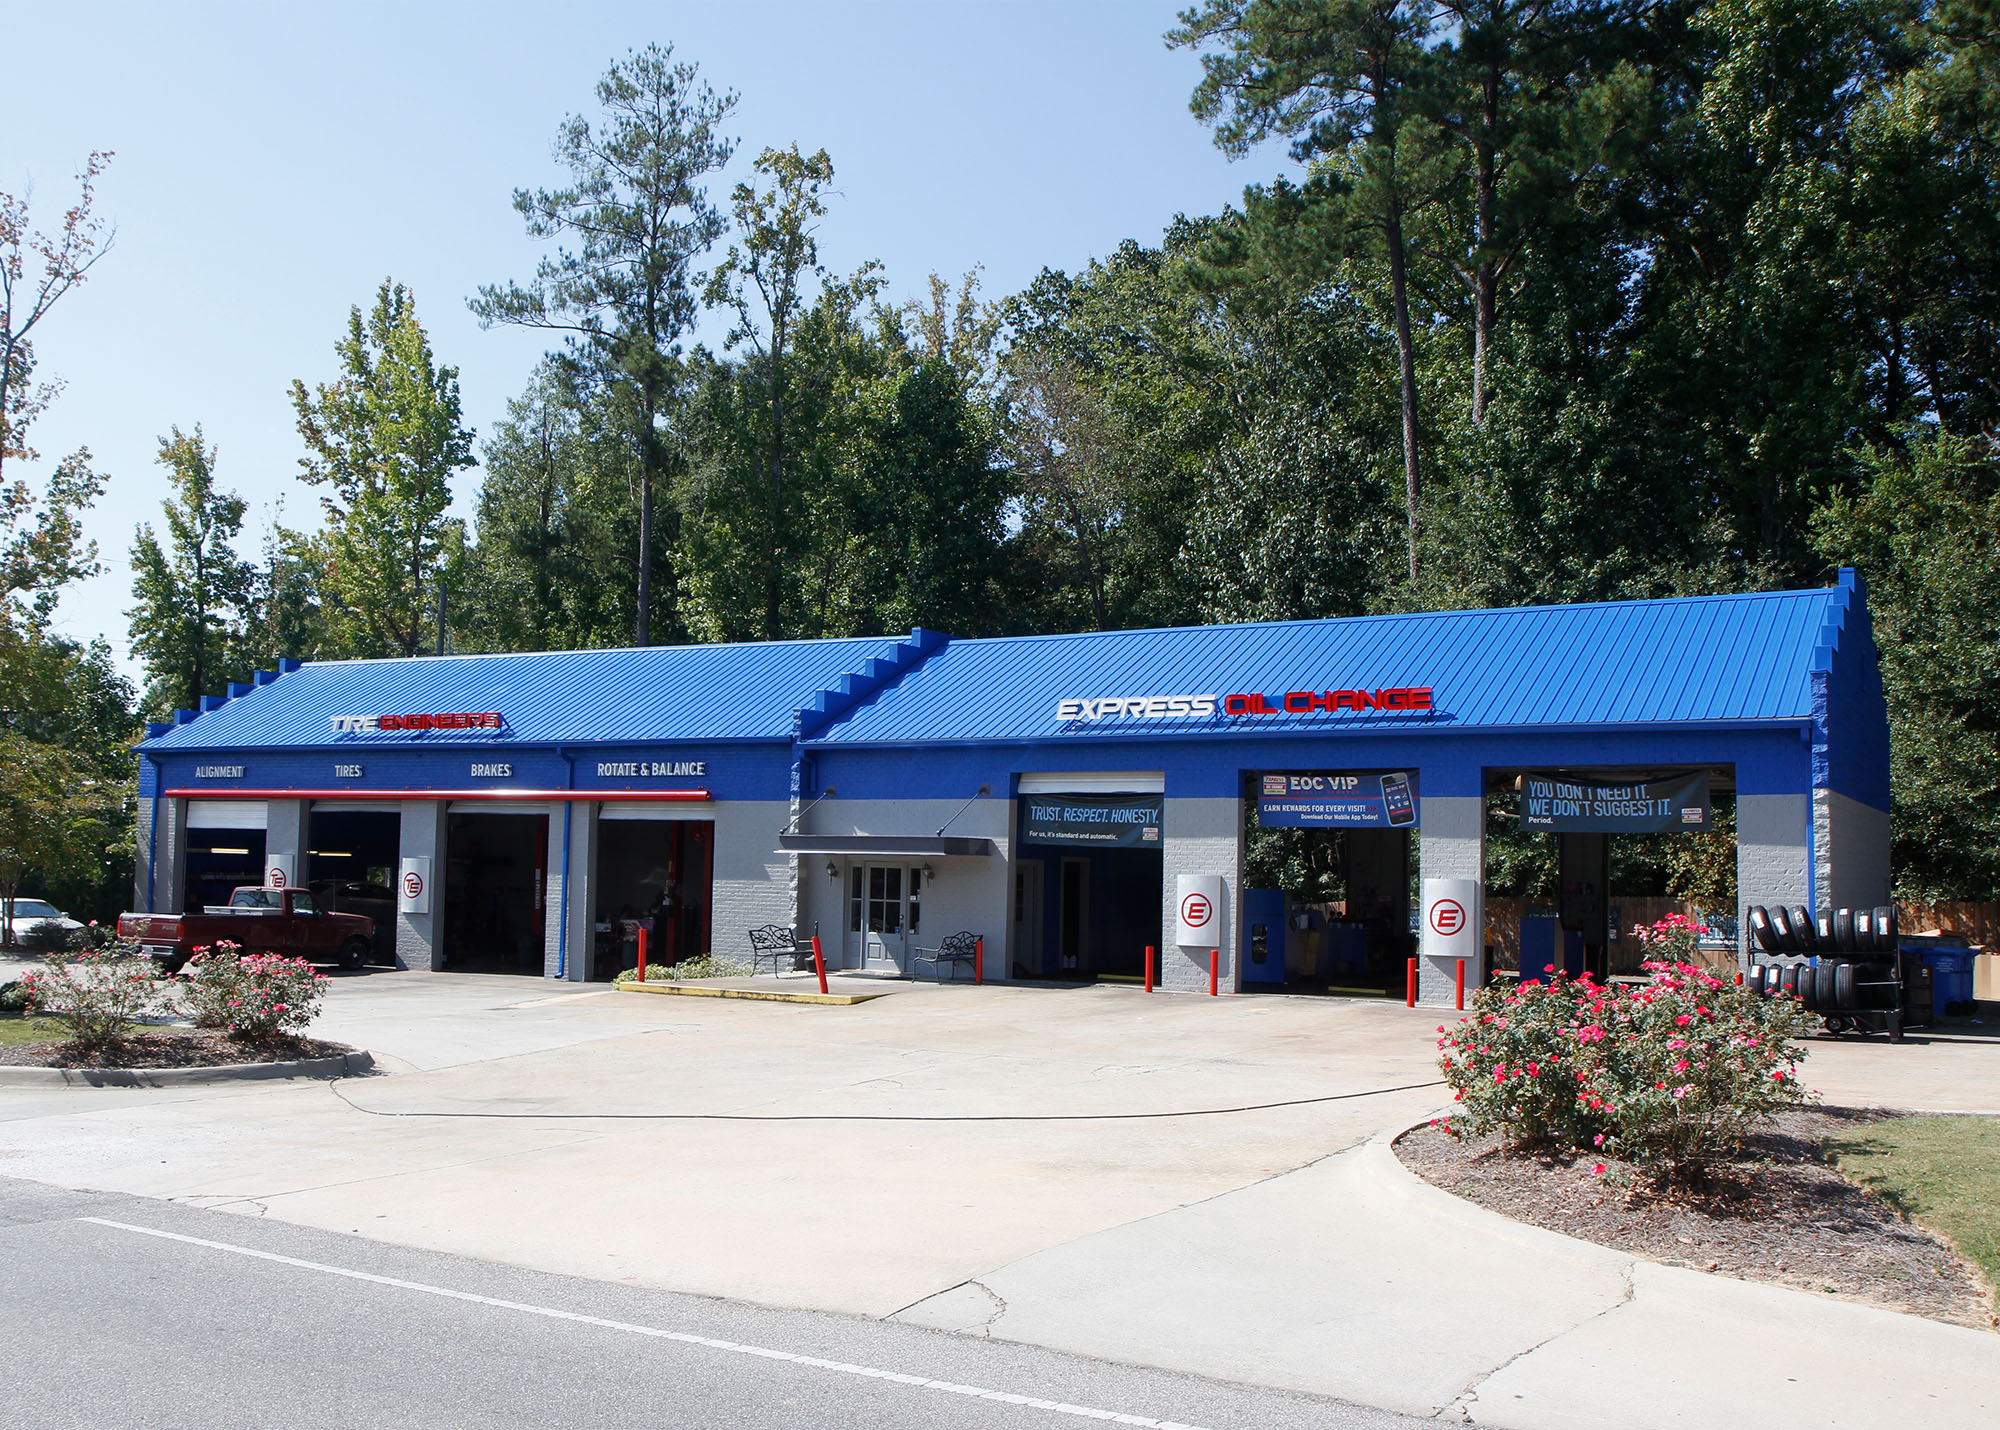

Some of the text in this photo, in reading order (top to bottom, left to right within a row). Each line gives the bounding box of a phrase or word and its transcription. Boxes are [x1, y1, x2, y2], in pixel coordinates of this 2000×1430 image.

[1056, 687, 1433, 720] EXPRESS OIL CHANGE
[330, 711, 501, 732] TIRE ENGINEERS
[195, 765, 244, 778] ALIGNMENT
[334, 765, 362, 777] TIRES
[471, 764, 511, 777] BRAKES
[598, 762, 705, 776] ROTATE & BALANCE
[1289, 776, 1359, 790] EOC VIP
[1529, 781, 1553, 798] YOU
[1597, 787, 1631, 800] NEED
[1635, 784, 1650, 799] IT.
[1031, 806, 1159, 824] TRUST. RESPECT. HONESTY.
[1264, 804, 1366, 812] EARN REWARDS FOR EVERY VISIT!
[1529, 799, 1550, 816] WE
[1553, 799, 1591, 817] DON'T
[1594, 800, 1653, 817] SUGGEST
[1657, 799, 1672, 816] IT.
[1362, 813, 1378, 821] Today!
[1528, 816, 1554, 824] Period.
[270, 874, 284, 887] TE
[405, 878, 420, 893] TE
[1188, 902, 1207, 919] E
[1437, 909, 1459, 927] E
